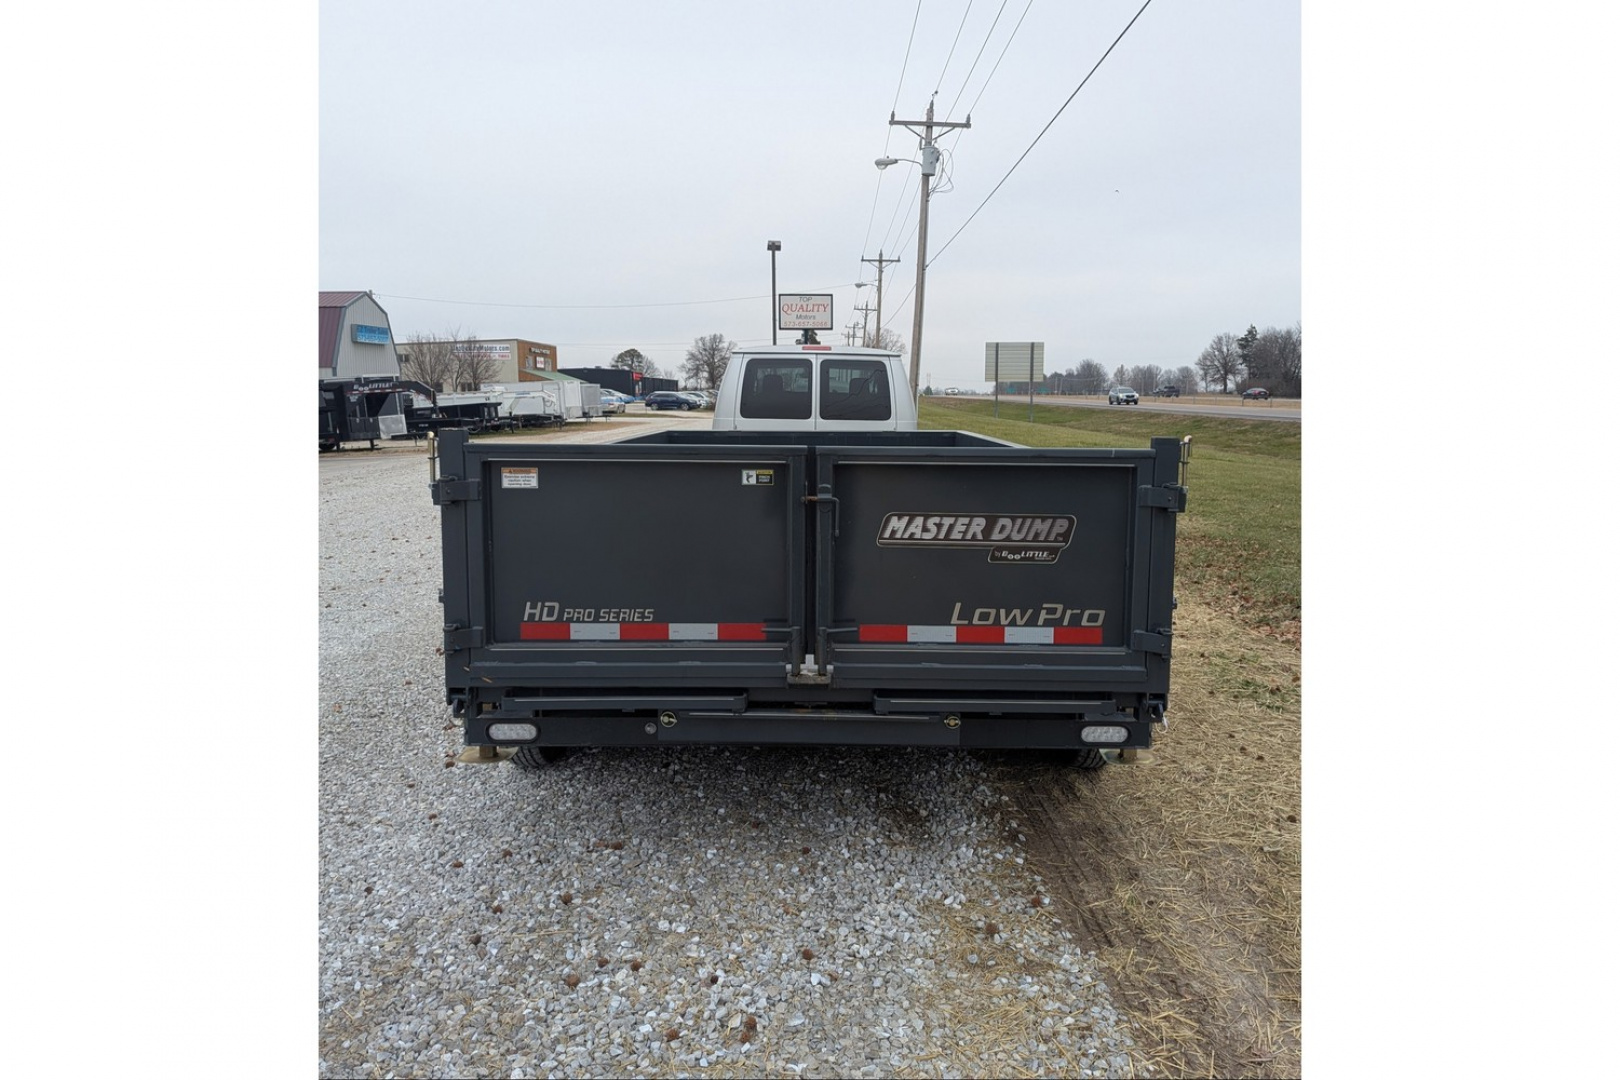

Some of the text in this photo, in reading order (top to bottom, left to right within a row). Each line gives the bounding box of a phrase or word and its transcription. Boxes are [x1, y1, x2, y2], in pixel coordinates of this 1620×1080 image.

[782, 303, 829, 315] QUALITY
[883, 515, 1069, 541] MASTER DUMP
[523, 601, 655, 622] HD PRO SERIES
[950, 602, 1106, 626] Low Pro
